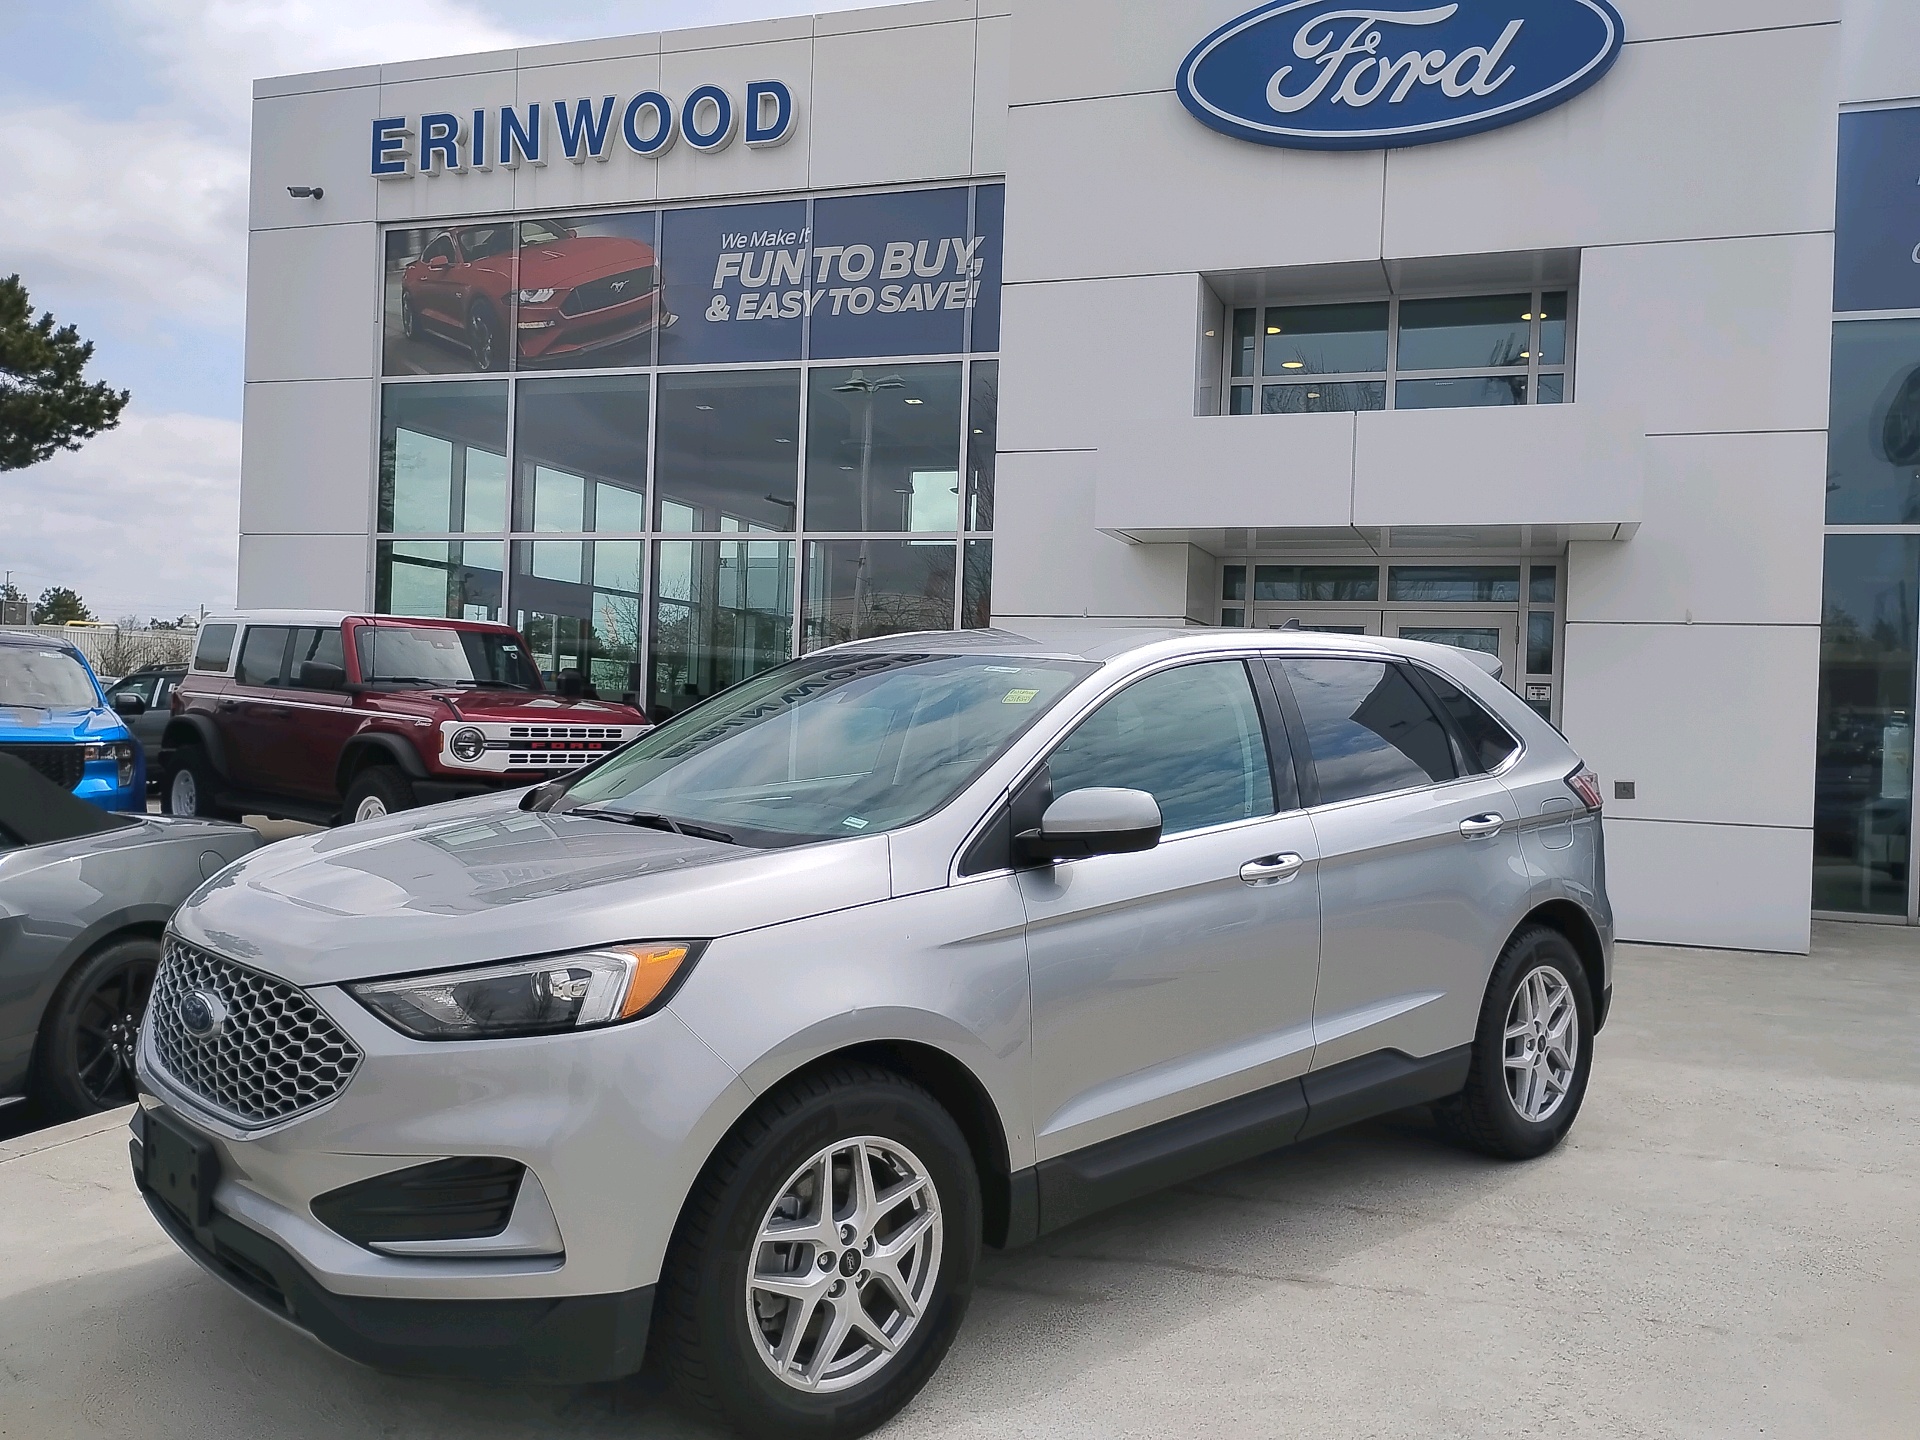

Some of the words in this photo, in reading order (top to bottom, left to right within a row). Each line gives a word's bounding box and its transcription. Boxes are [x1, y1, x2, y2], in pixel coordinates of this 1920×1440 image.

[1266, 3, 1525, 113] Ford
[371, 79, 797, 180] ERINWOOD
[721, 232, 748, 249] We
[750, 228, 796, 247] Make
[798, 226, 811, 244] It
[713, 249, 806, 289] FUN
[813, 244, 875, 283] TO
[880, 236, 985, 279] BUY,
[705, 294, 731, 322] &
[736, 289, 826, 321] EASY
[829, 286, 875, 316] TO
[876, 280, 981, 313] SAVE!
[531, 742, 602, 750] FORD
